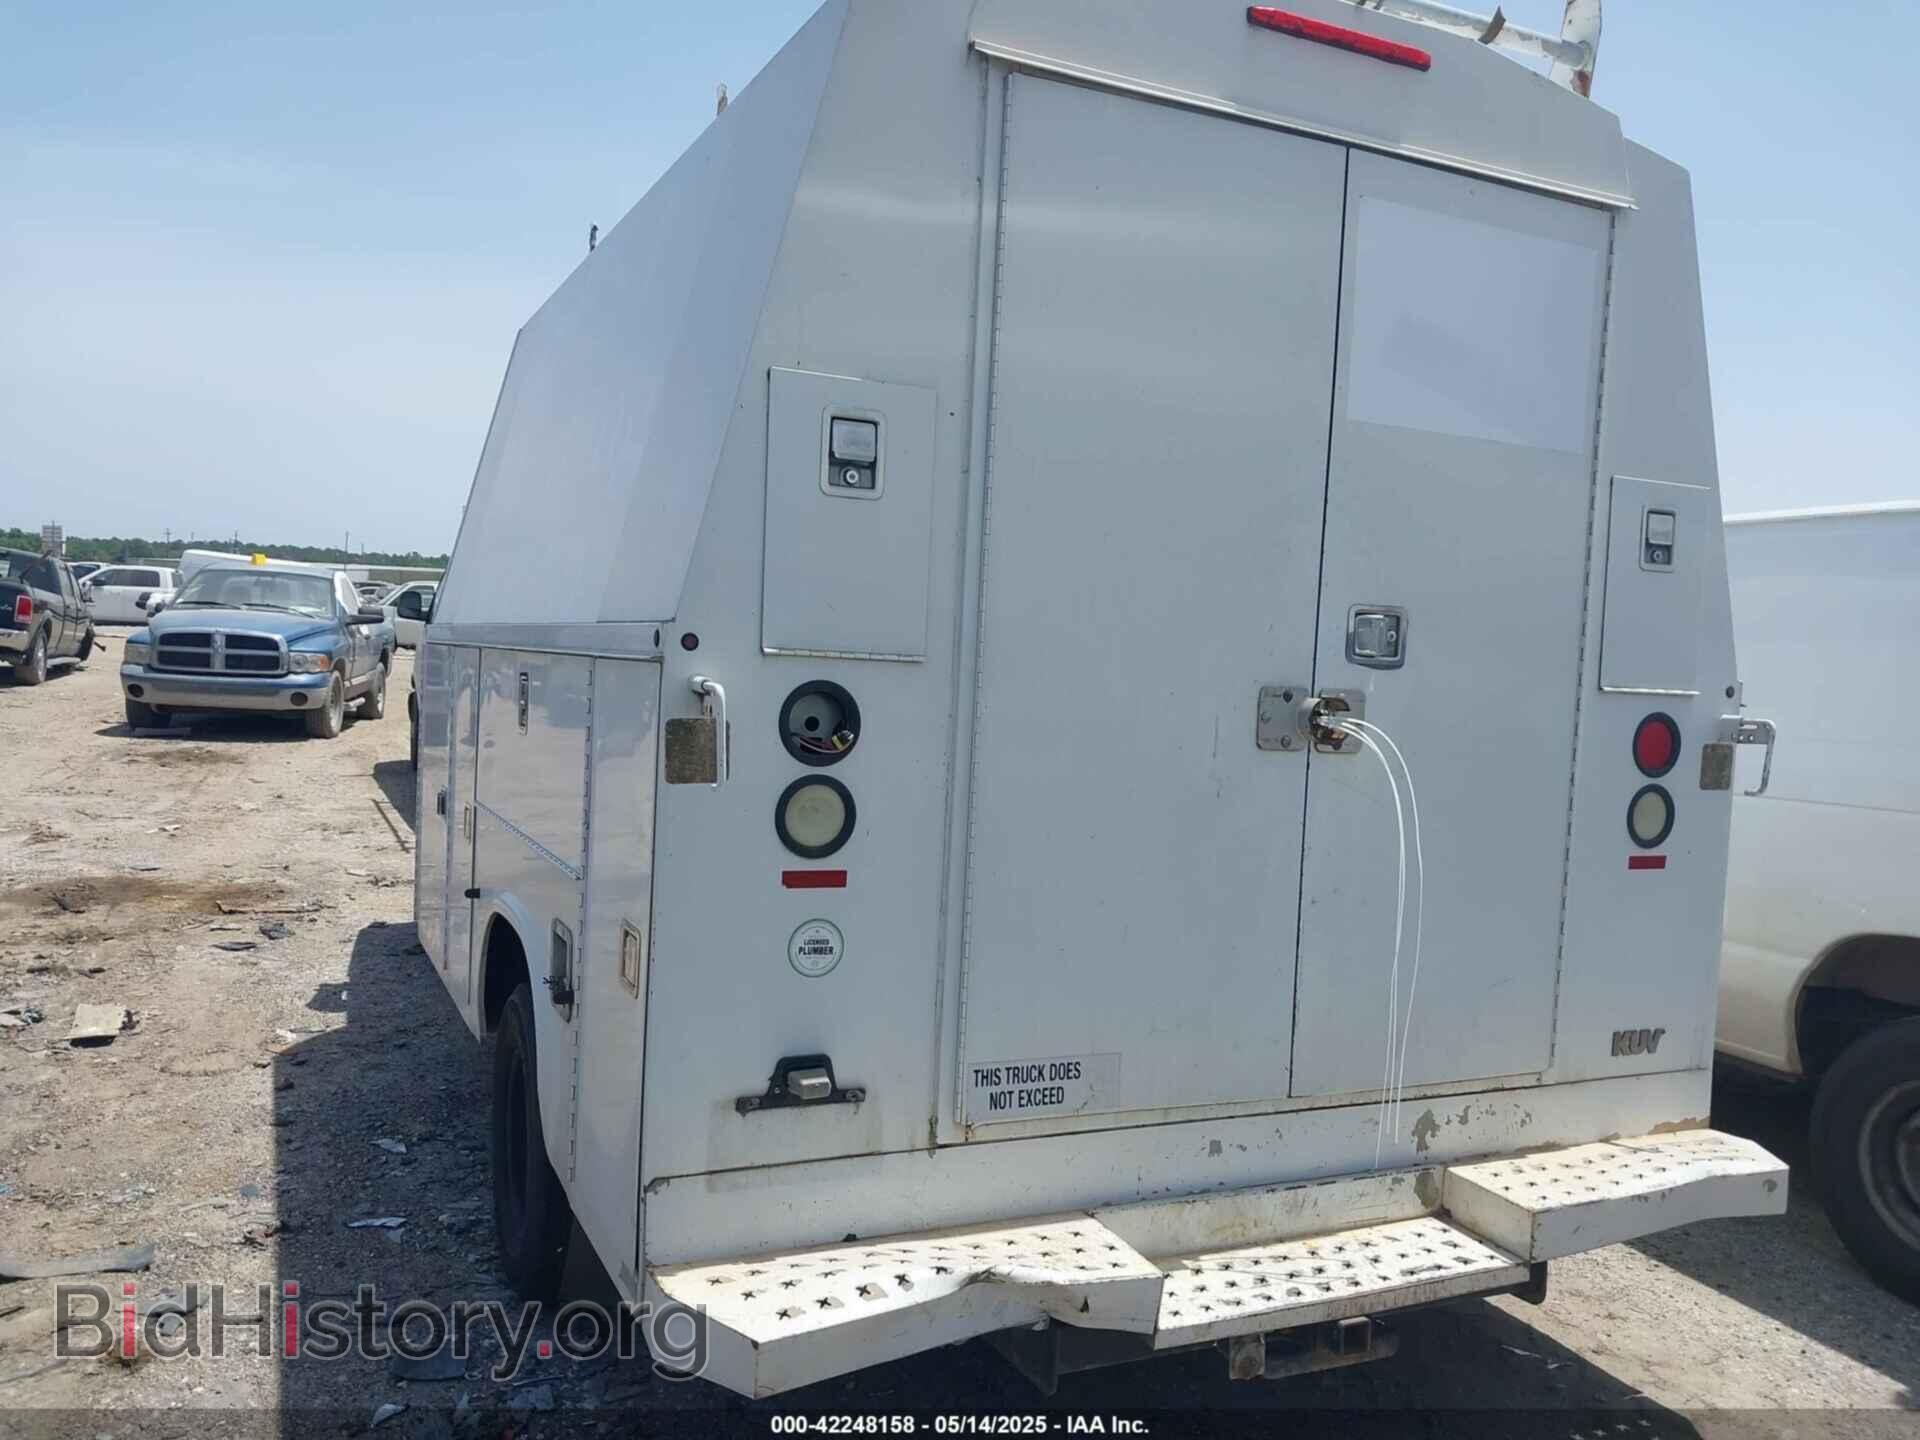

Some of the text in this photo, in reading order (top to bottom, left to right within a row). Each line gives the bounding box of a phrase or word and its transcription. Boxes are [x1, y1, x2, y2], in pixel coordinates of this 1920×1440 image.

[798, 946, 834, 956] PLUMBER
[1611, 1028, 1666, 1056] KUV
[973, 1061, 1081, 1088] THIS TRUCK DOES
[988, 1086, 1065, 1111] NOT EXCEED
